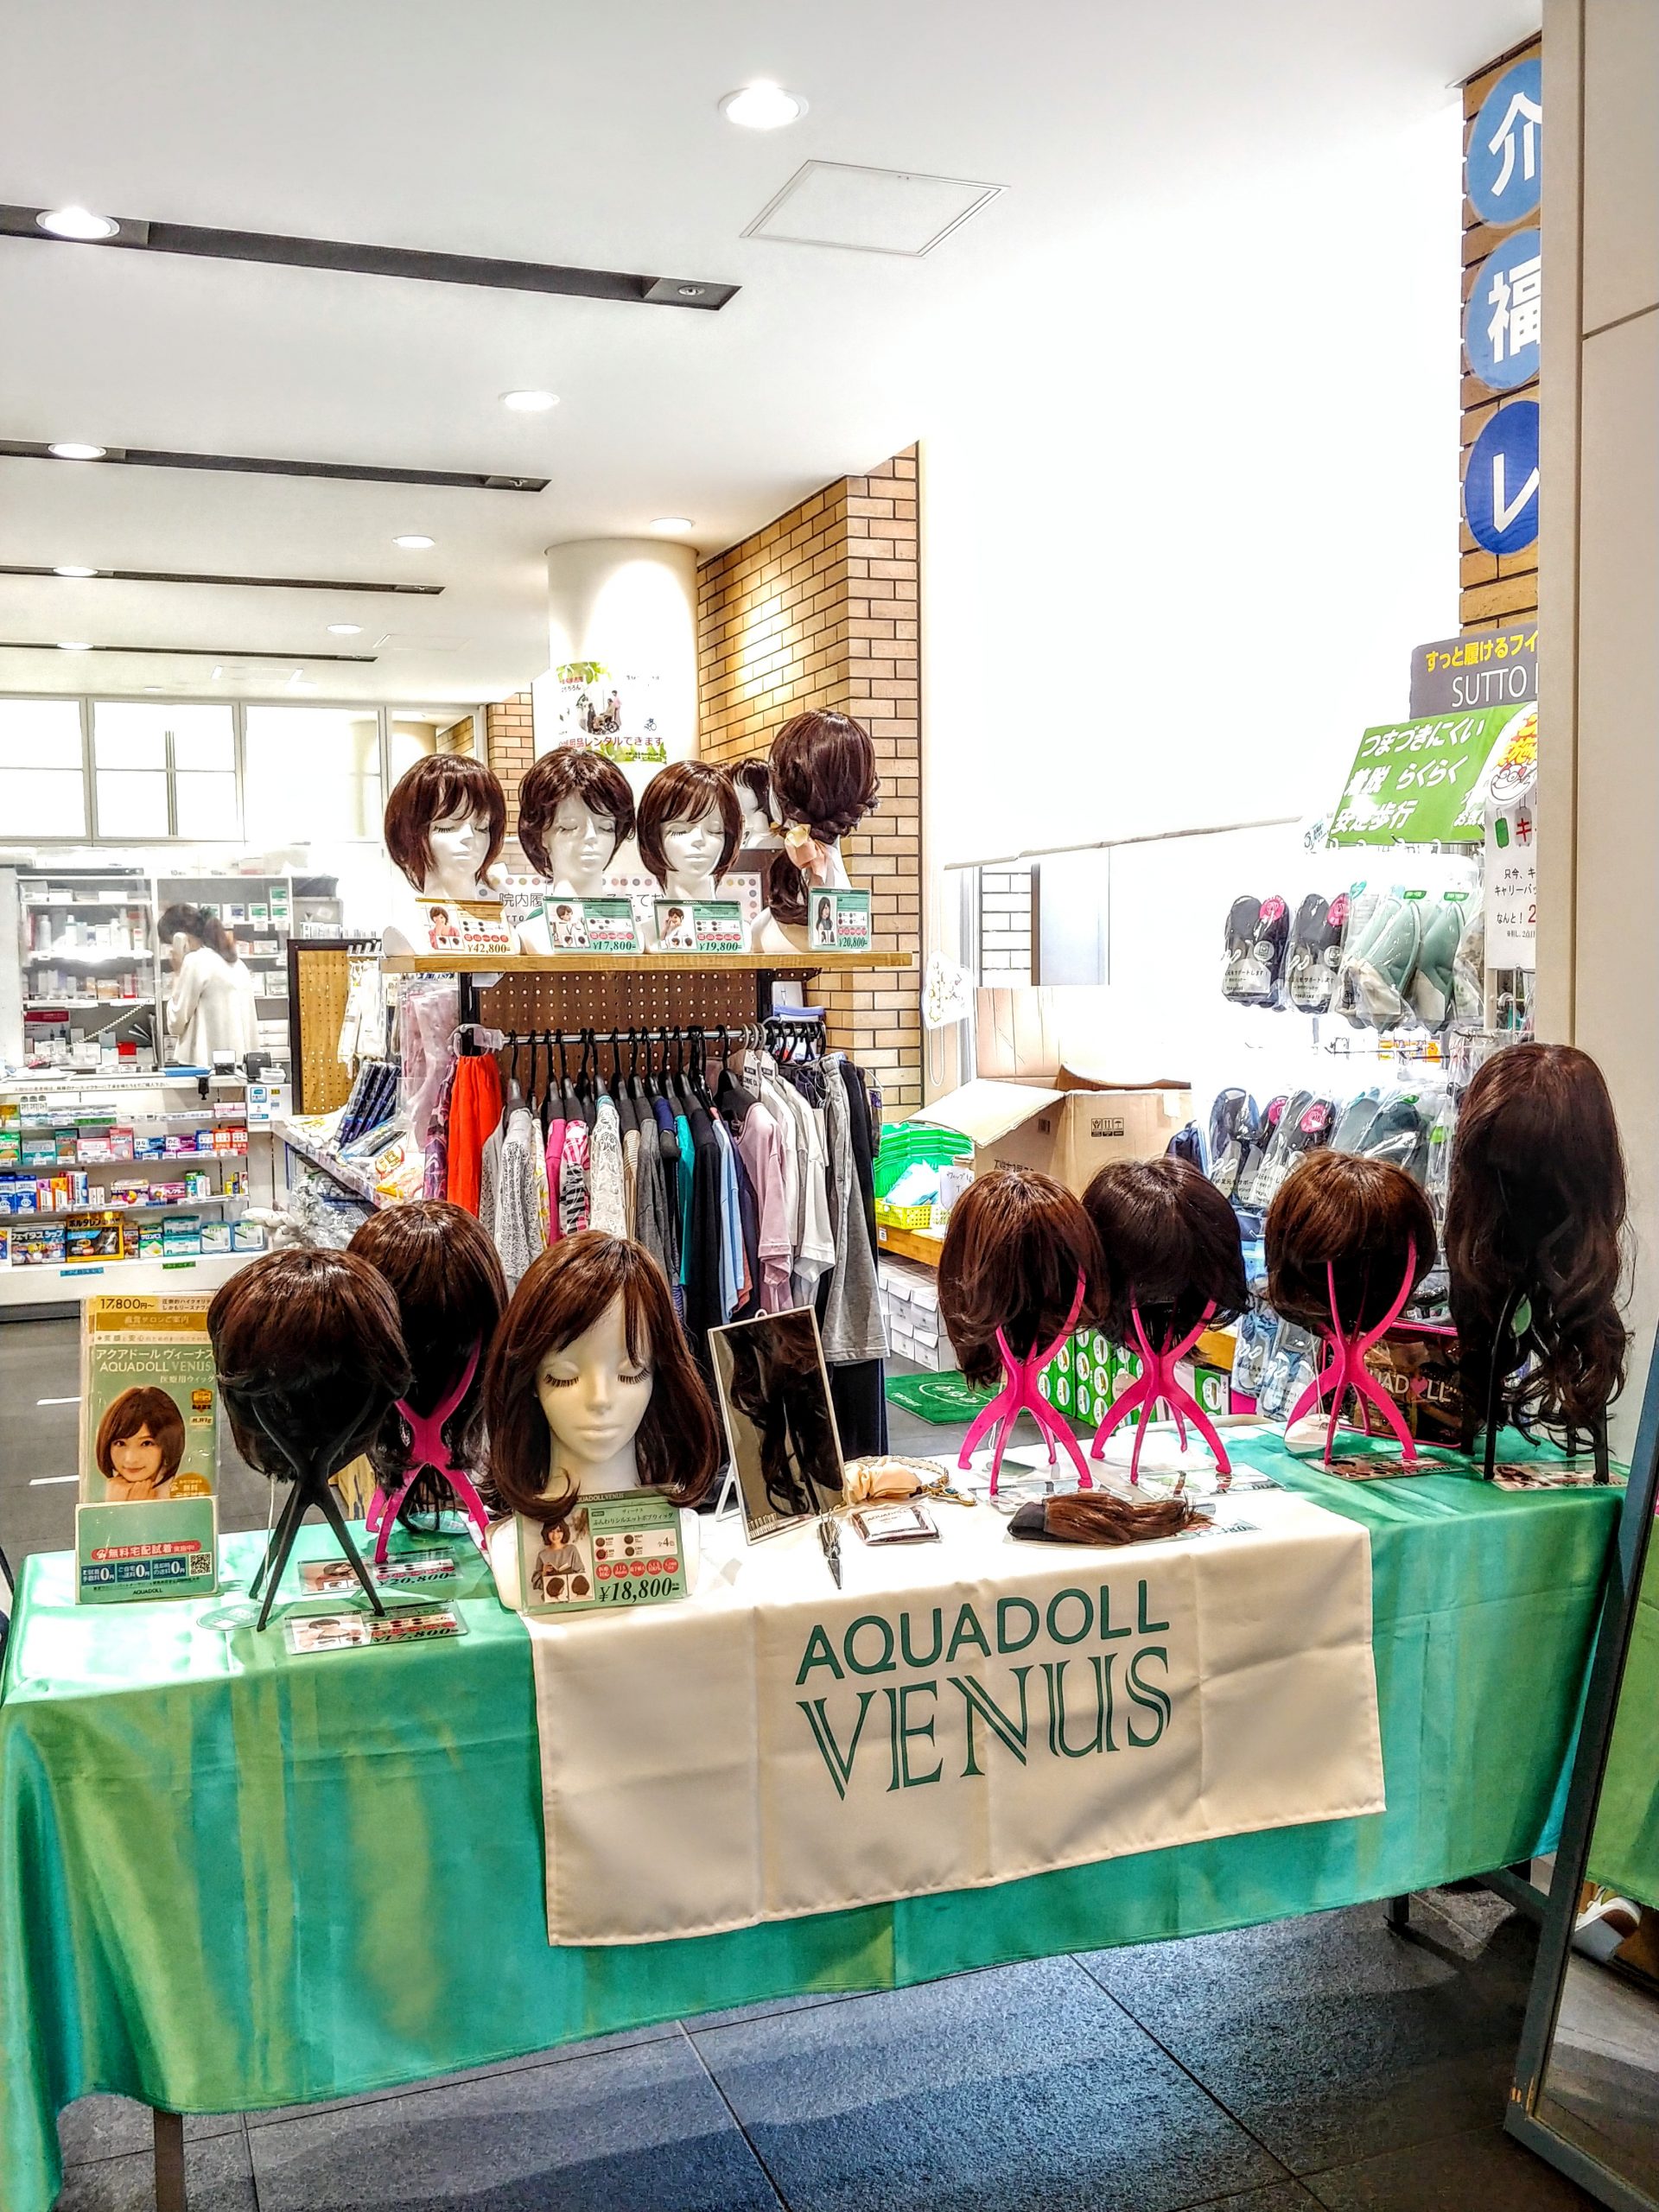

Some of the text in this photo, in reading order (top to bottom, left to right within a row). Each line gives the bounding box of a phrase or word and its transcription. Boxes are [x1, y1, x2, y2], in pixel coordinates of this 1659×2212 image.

[1491, 452, 1541, 532] レ
[1452, 664, 1528, 708] SUTTO
[1361, 716, 1485, 758] つまづきにくい
[1395, 754, 1469, 791] らくらく
[95, 1349, 161, 1361] アクアドール
[99, 1361, 169, 1373] AQUADOLL
[795, 1579, 1170, 1686] AQUADOLL
[795, 1645, 1173, 1802] VENUS
